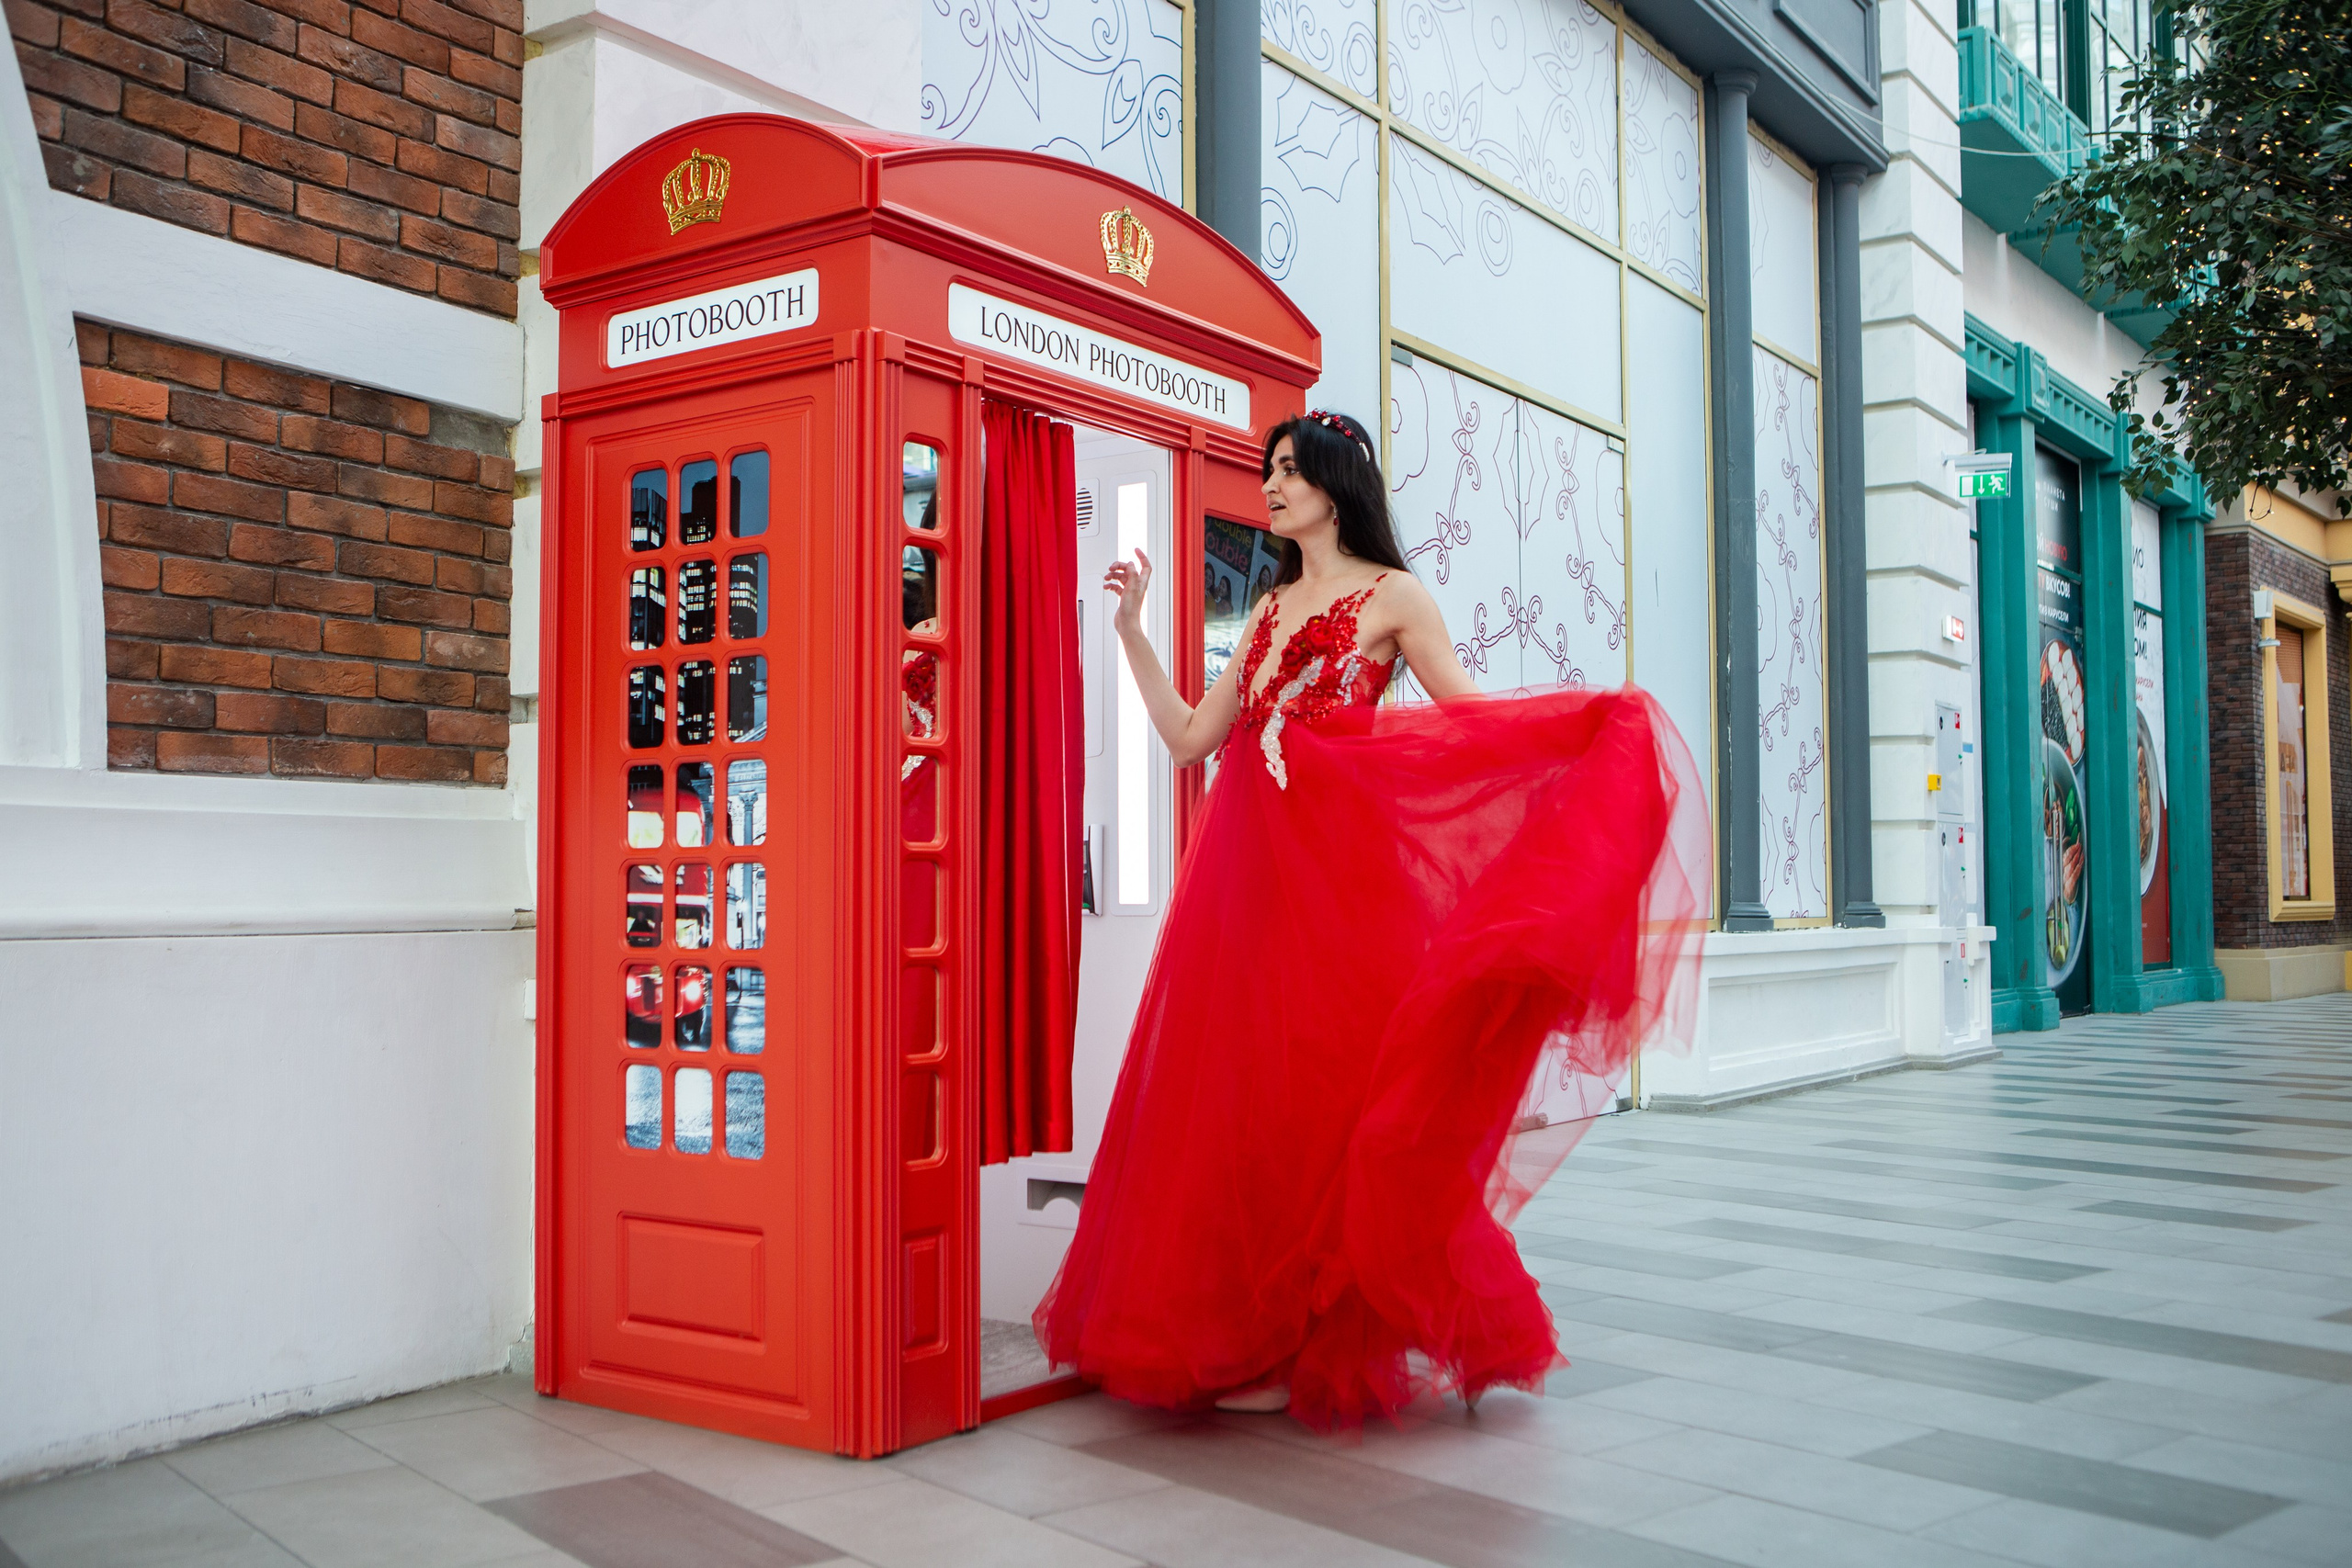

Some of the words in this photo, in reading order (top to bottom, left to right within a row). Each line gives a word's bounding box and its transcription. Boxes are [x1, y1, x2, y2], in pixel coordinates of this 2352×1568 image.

[621, 285, 804, 355] PHOTOBOOTH
[981, 306, 1080, 366] LONDON
[1090, 343, 1226, 414] PHOTOBOOTH
